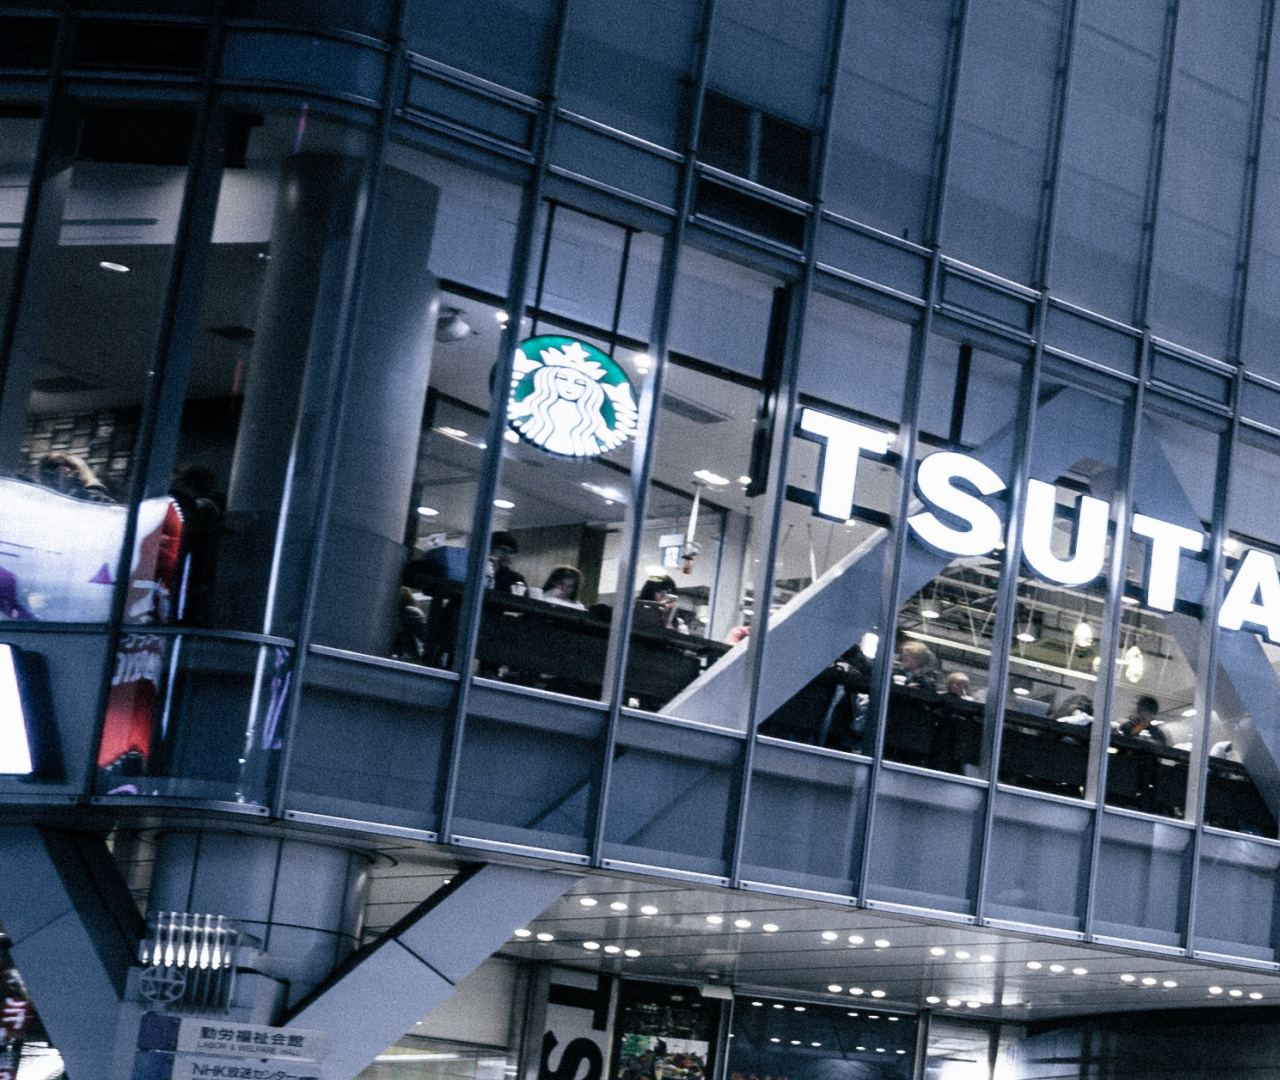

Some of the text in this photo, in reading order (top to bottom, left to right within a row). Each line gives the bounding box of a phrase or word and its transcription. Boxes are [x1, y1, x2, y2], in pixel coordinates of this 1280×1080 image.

[199, 1025, 306, 1048] 勤労福祉会館
